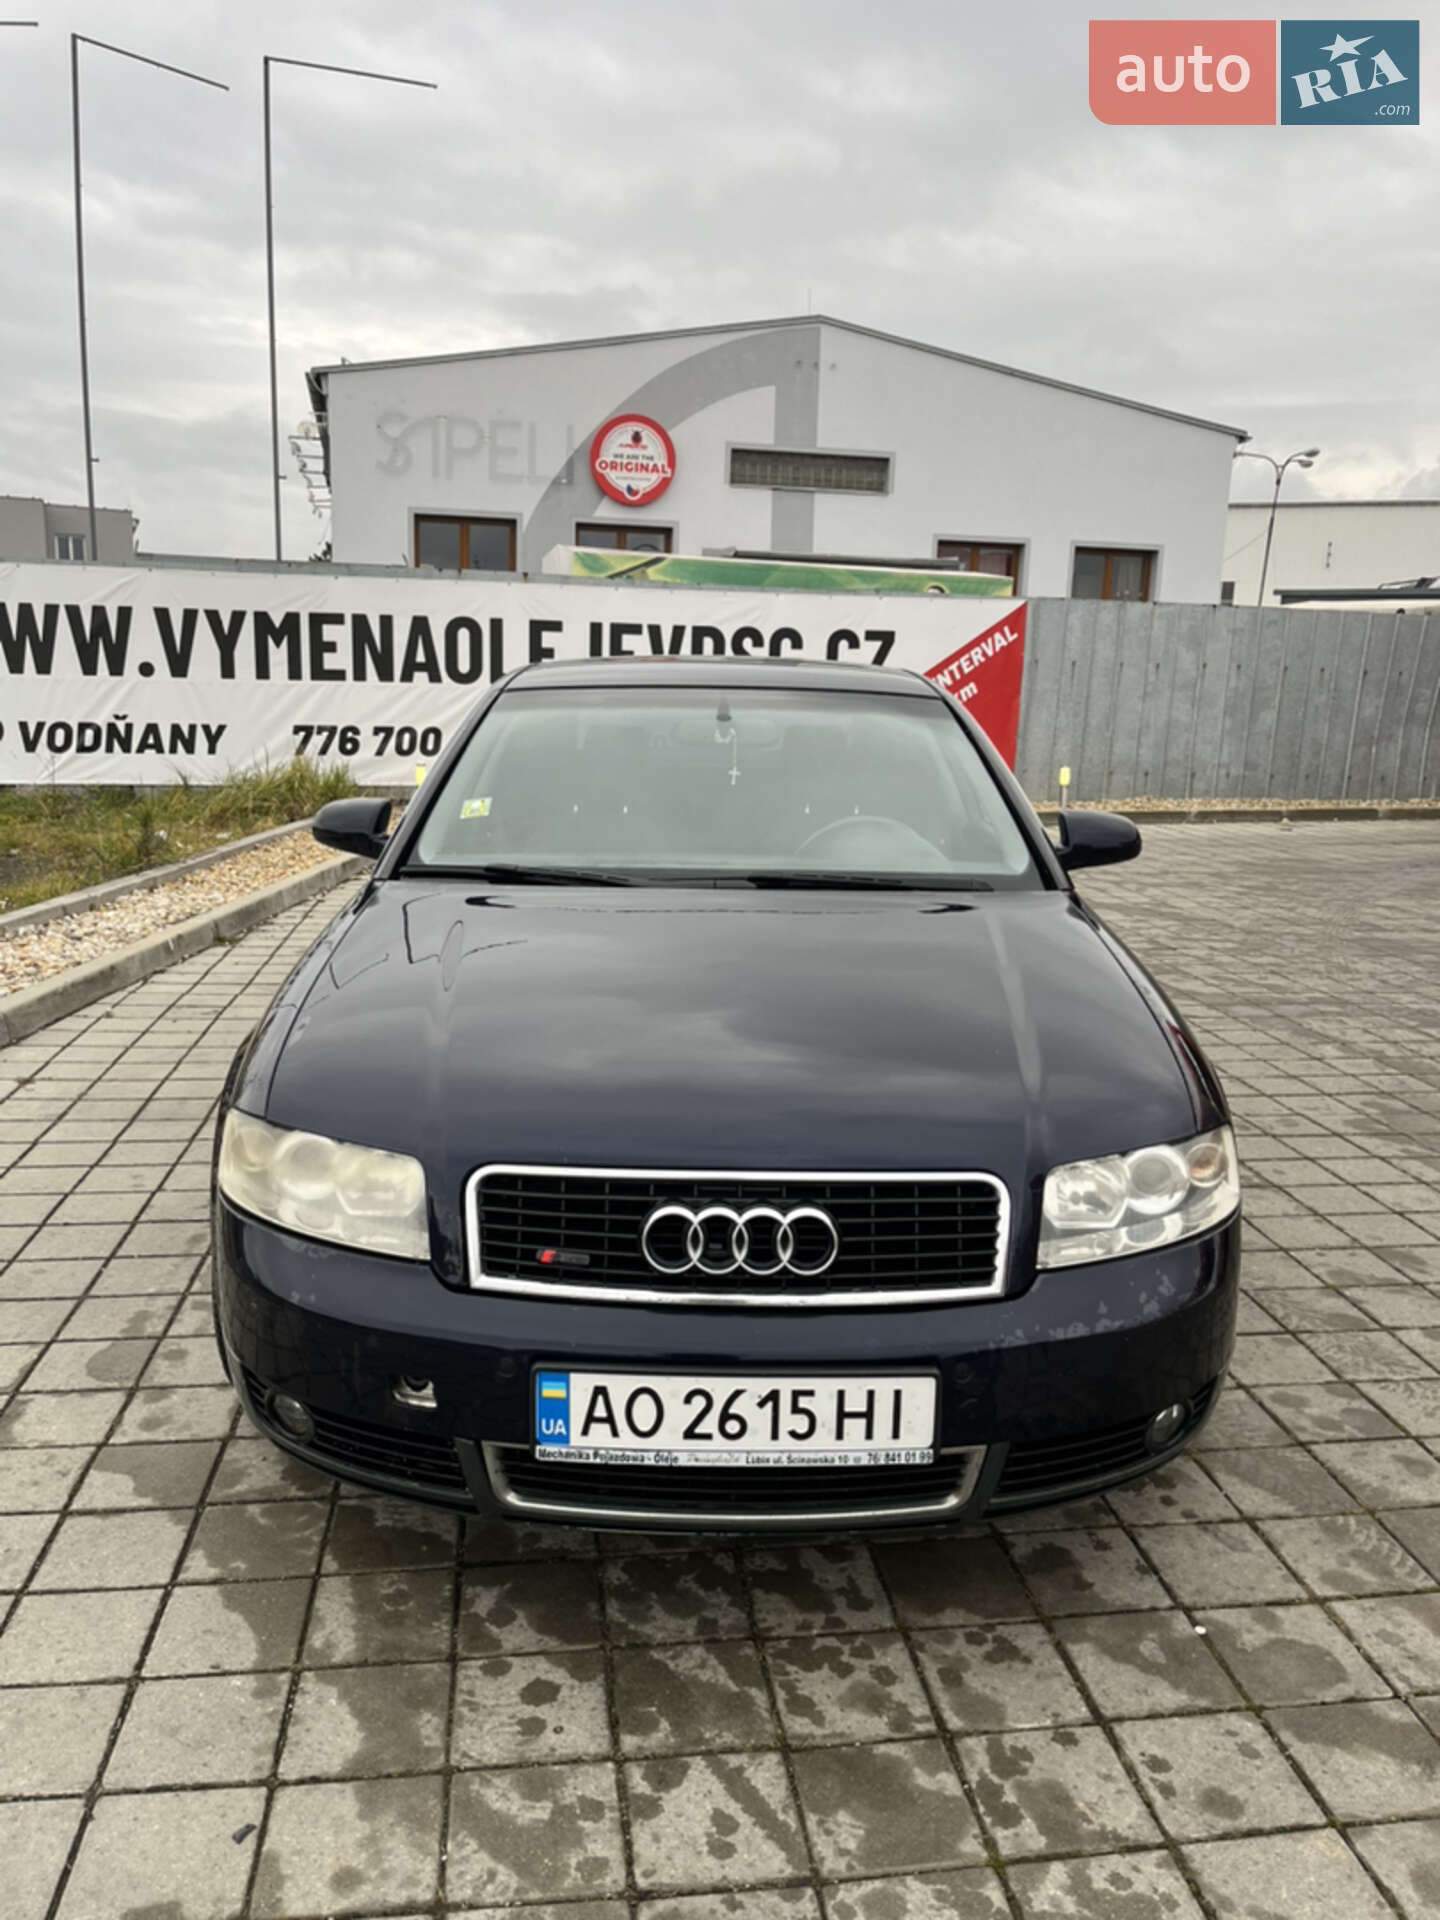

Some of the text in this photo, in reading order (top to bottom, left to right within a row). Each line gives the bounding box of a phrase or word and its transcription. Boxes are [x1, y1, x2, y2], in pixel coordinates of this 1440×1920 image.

[598, 459, 668, 475] ORIGINAL
[0, 602, 896, 685] WW.VYMENAOLEZ
[931, 624, 1019, 688] NTERVAL
[18, 713, 228, 756] VODŇANY
[292, 724, 361, 757] 776
[373, 725, 443, 758] 700
[541, 1419, 567, 1437] UA
[580, 1385, 903, 1442] AO 2615 HI
